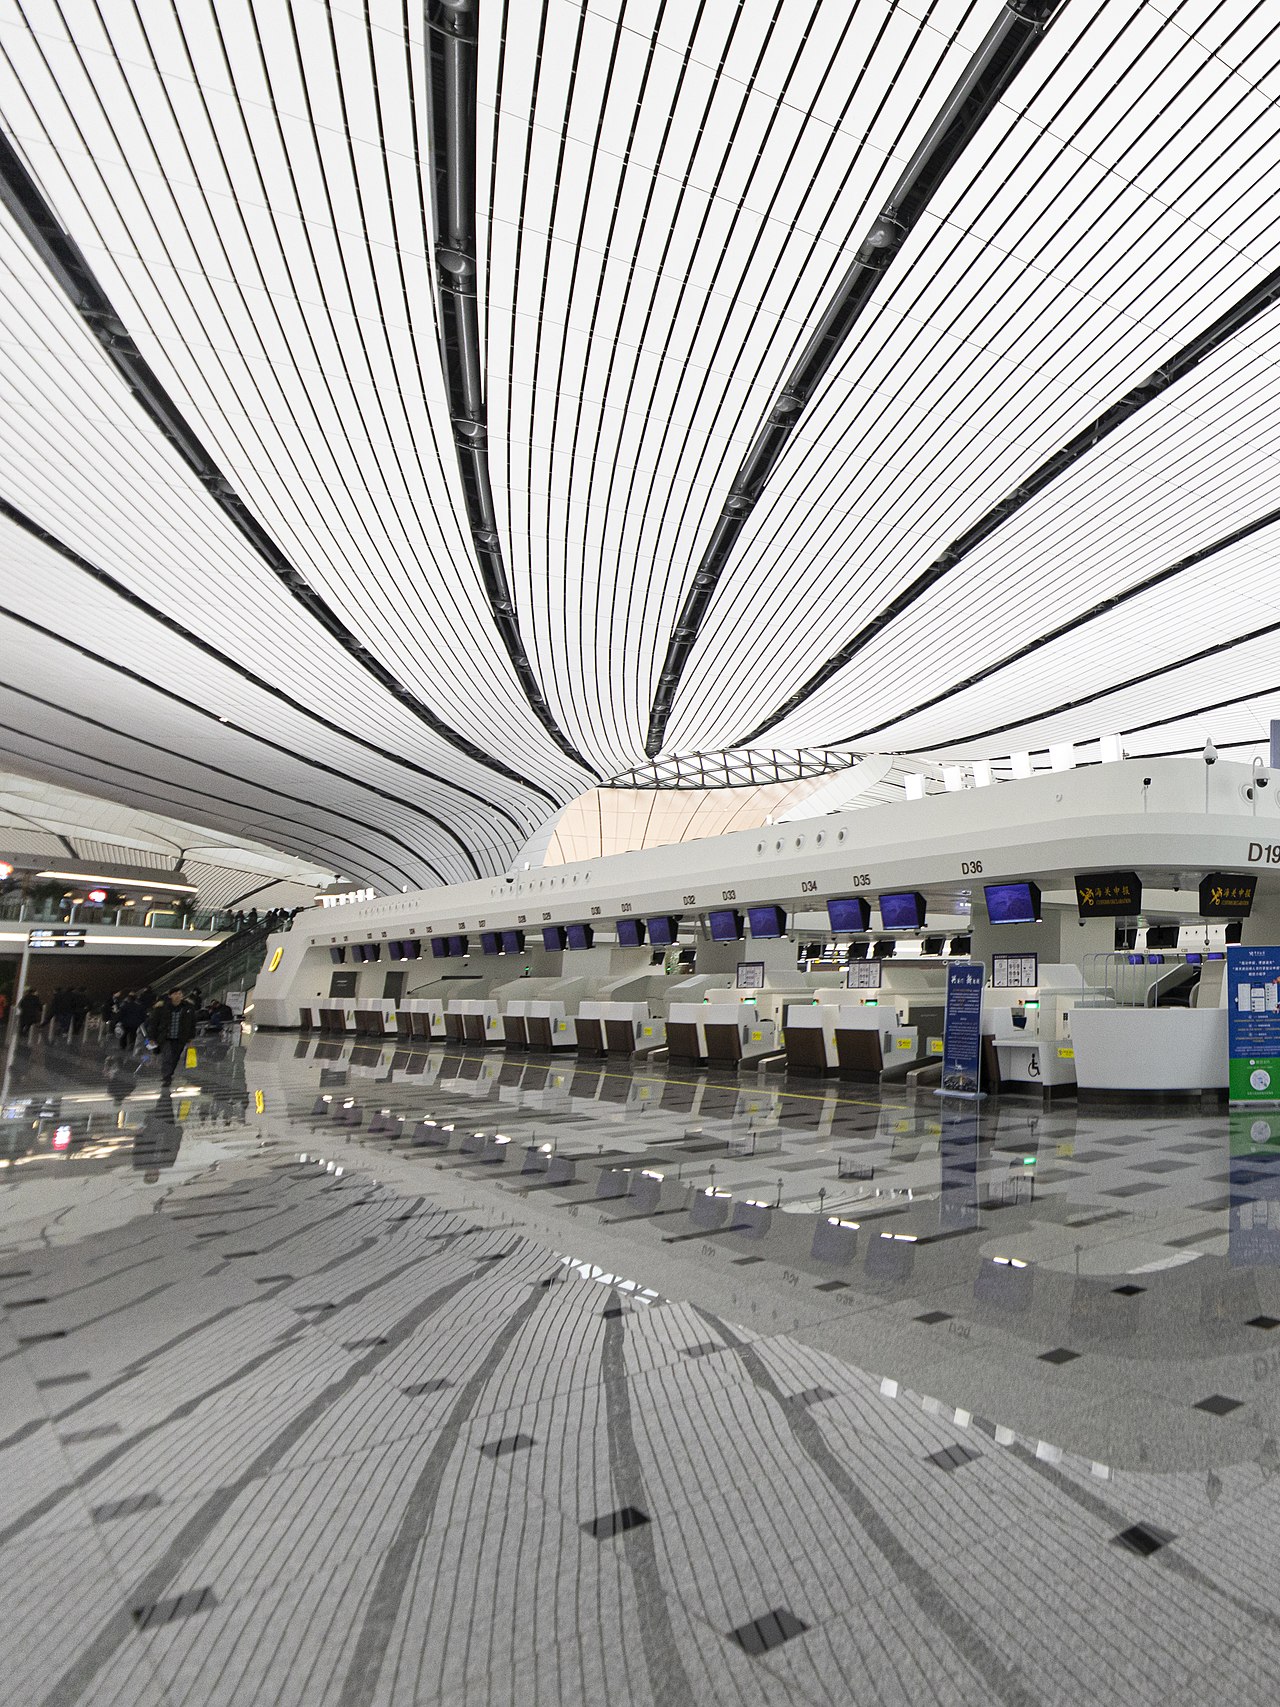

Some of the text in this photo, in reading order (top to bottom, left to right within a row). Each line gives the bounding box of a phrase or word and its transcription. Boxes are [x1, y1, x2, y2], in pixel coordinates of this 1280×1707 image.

[962, 861, 983, 875] D36
[801, 880, 818, 893] D34
[853, 874, 871, 887] D35
[683, 895, 696, 906] D32
[722, 889, 737, 901] D33
[621, 903, 632, 913] D31
[268, 946, 284, 972] D
